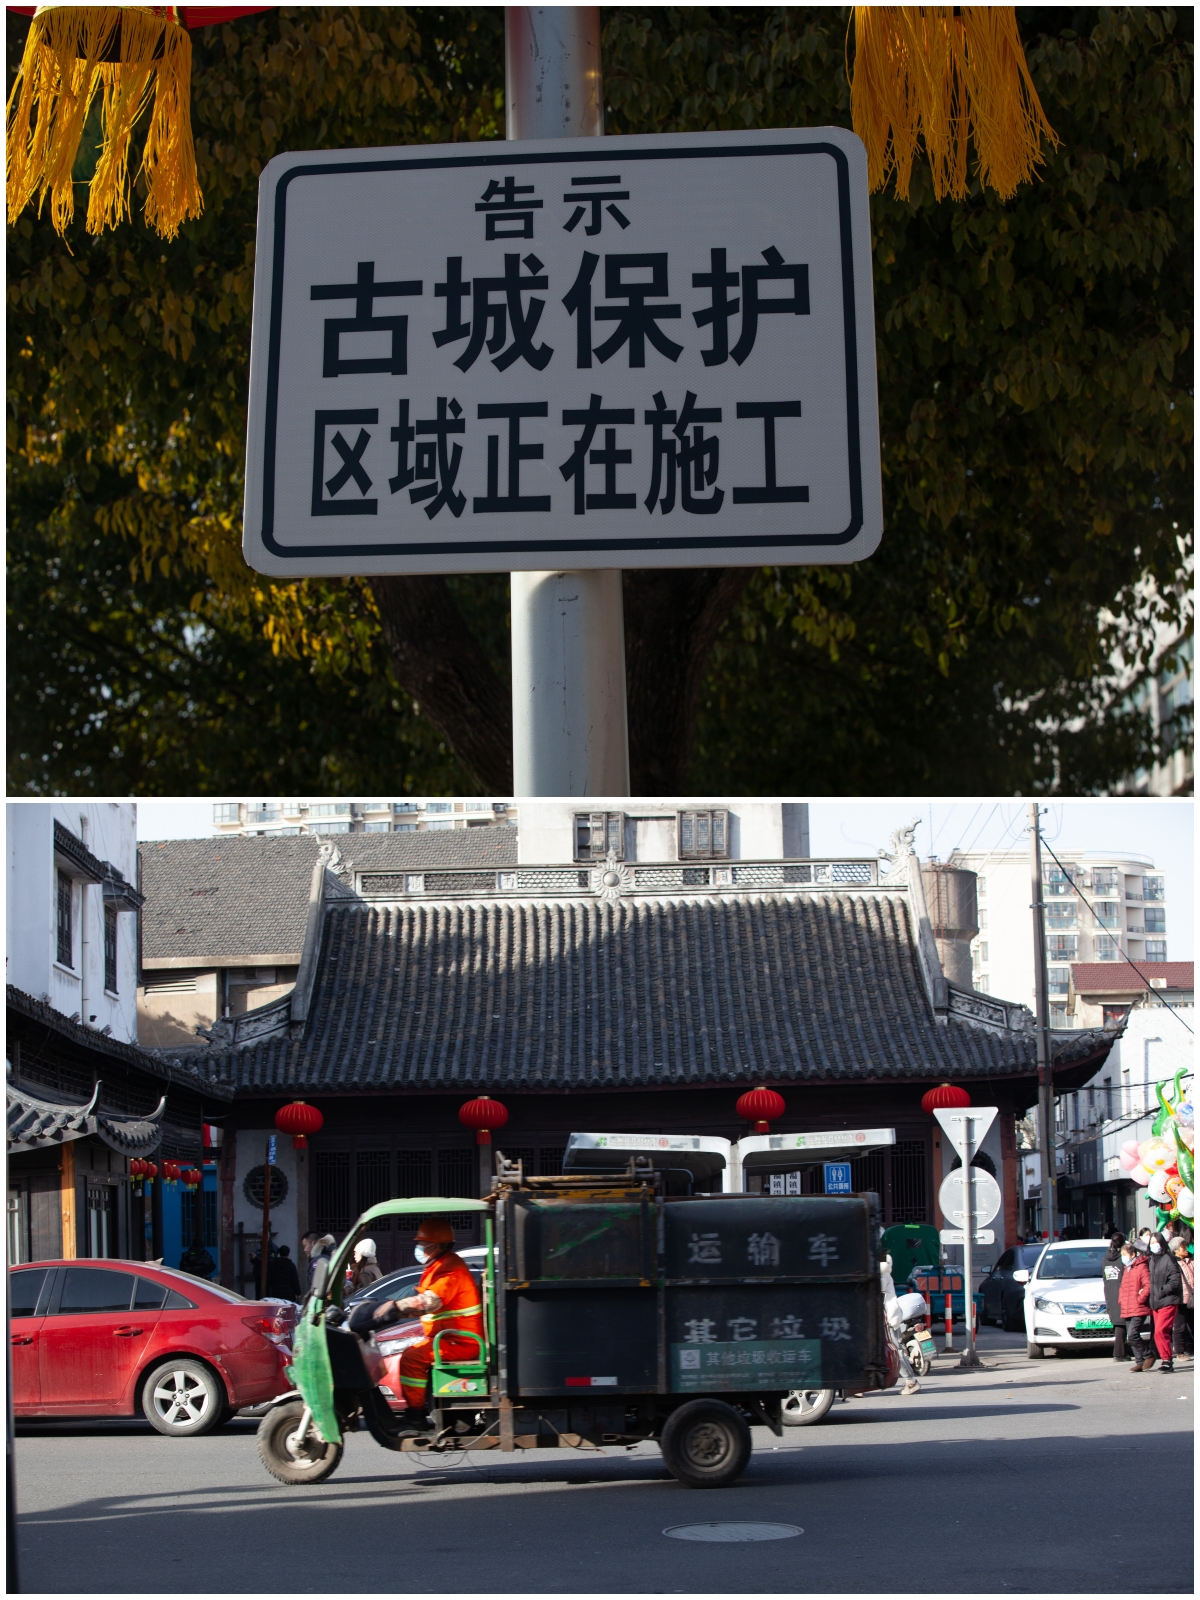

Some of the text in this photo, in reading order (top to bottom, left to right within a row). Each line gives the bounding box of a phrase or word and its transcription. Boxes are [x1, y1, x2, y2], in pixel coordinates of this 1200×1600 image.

[475, 175, 631, 241] 告示
[310, 245, 811, 378] 古城保护
[311, 390, 810, 521] 区域正在施工
[688, 1232, 839, 1267] 运输车
[684, 1315, 852, 1344] 其它垃圾
[705, 1349, 812, 1366] 其他垃圾收运车
